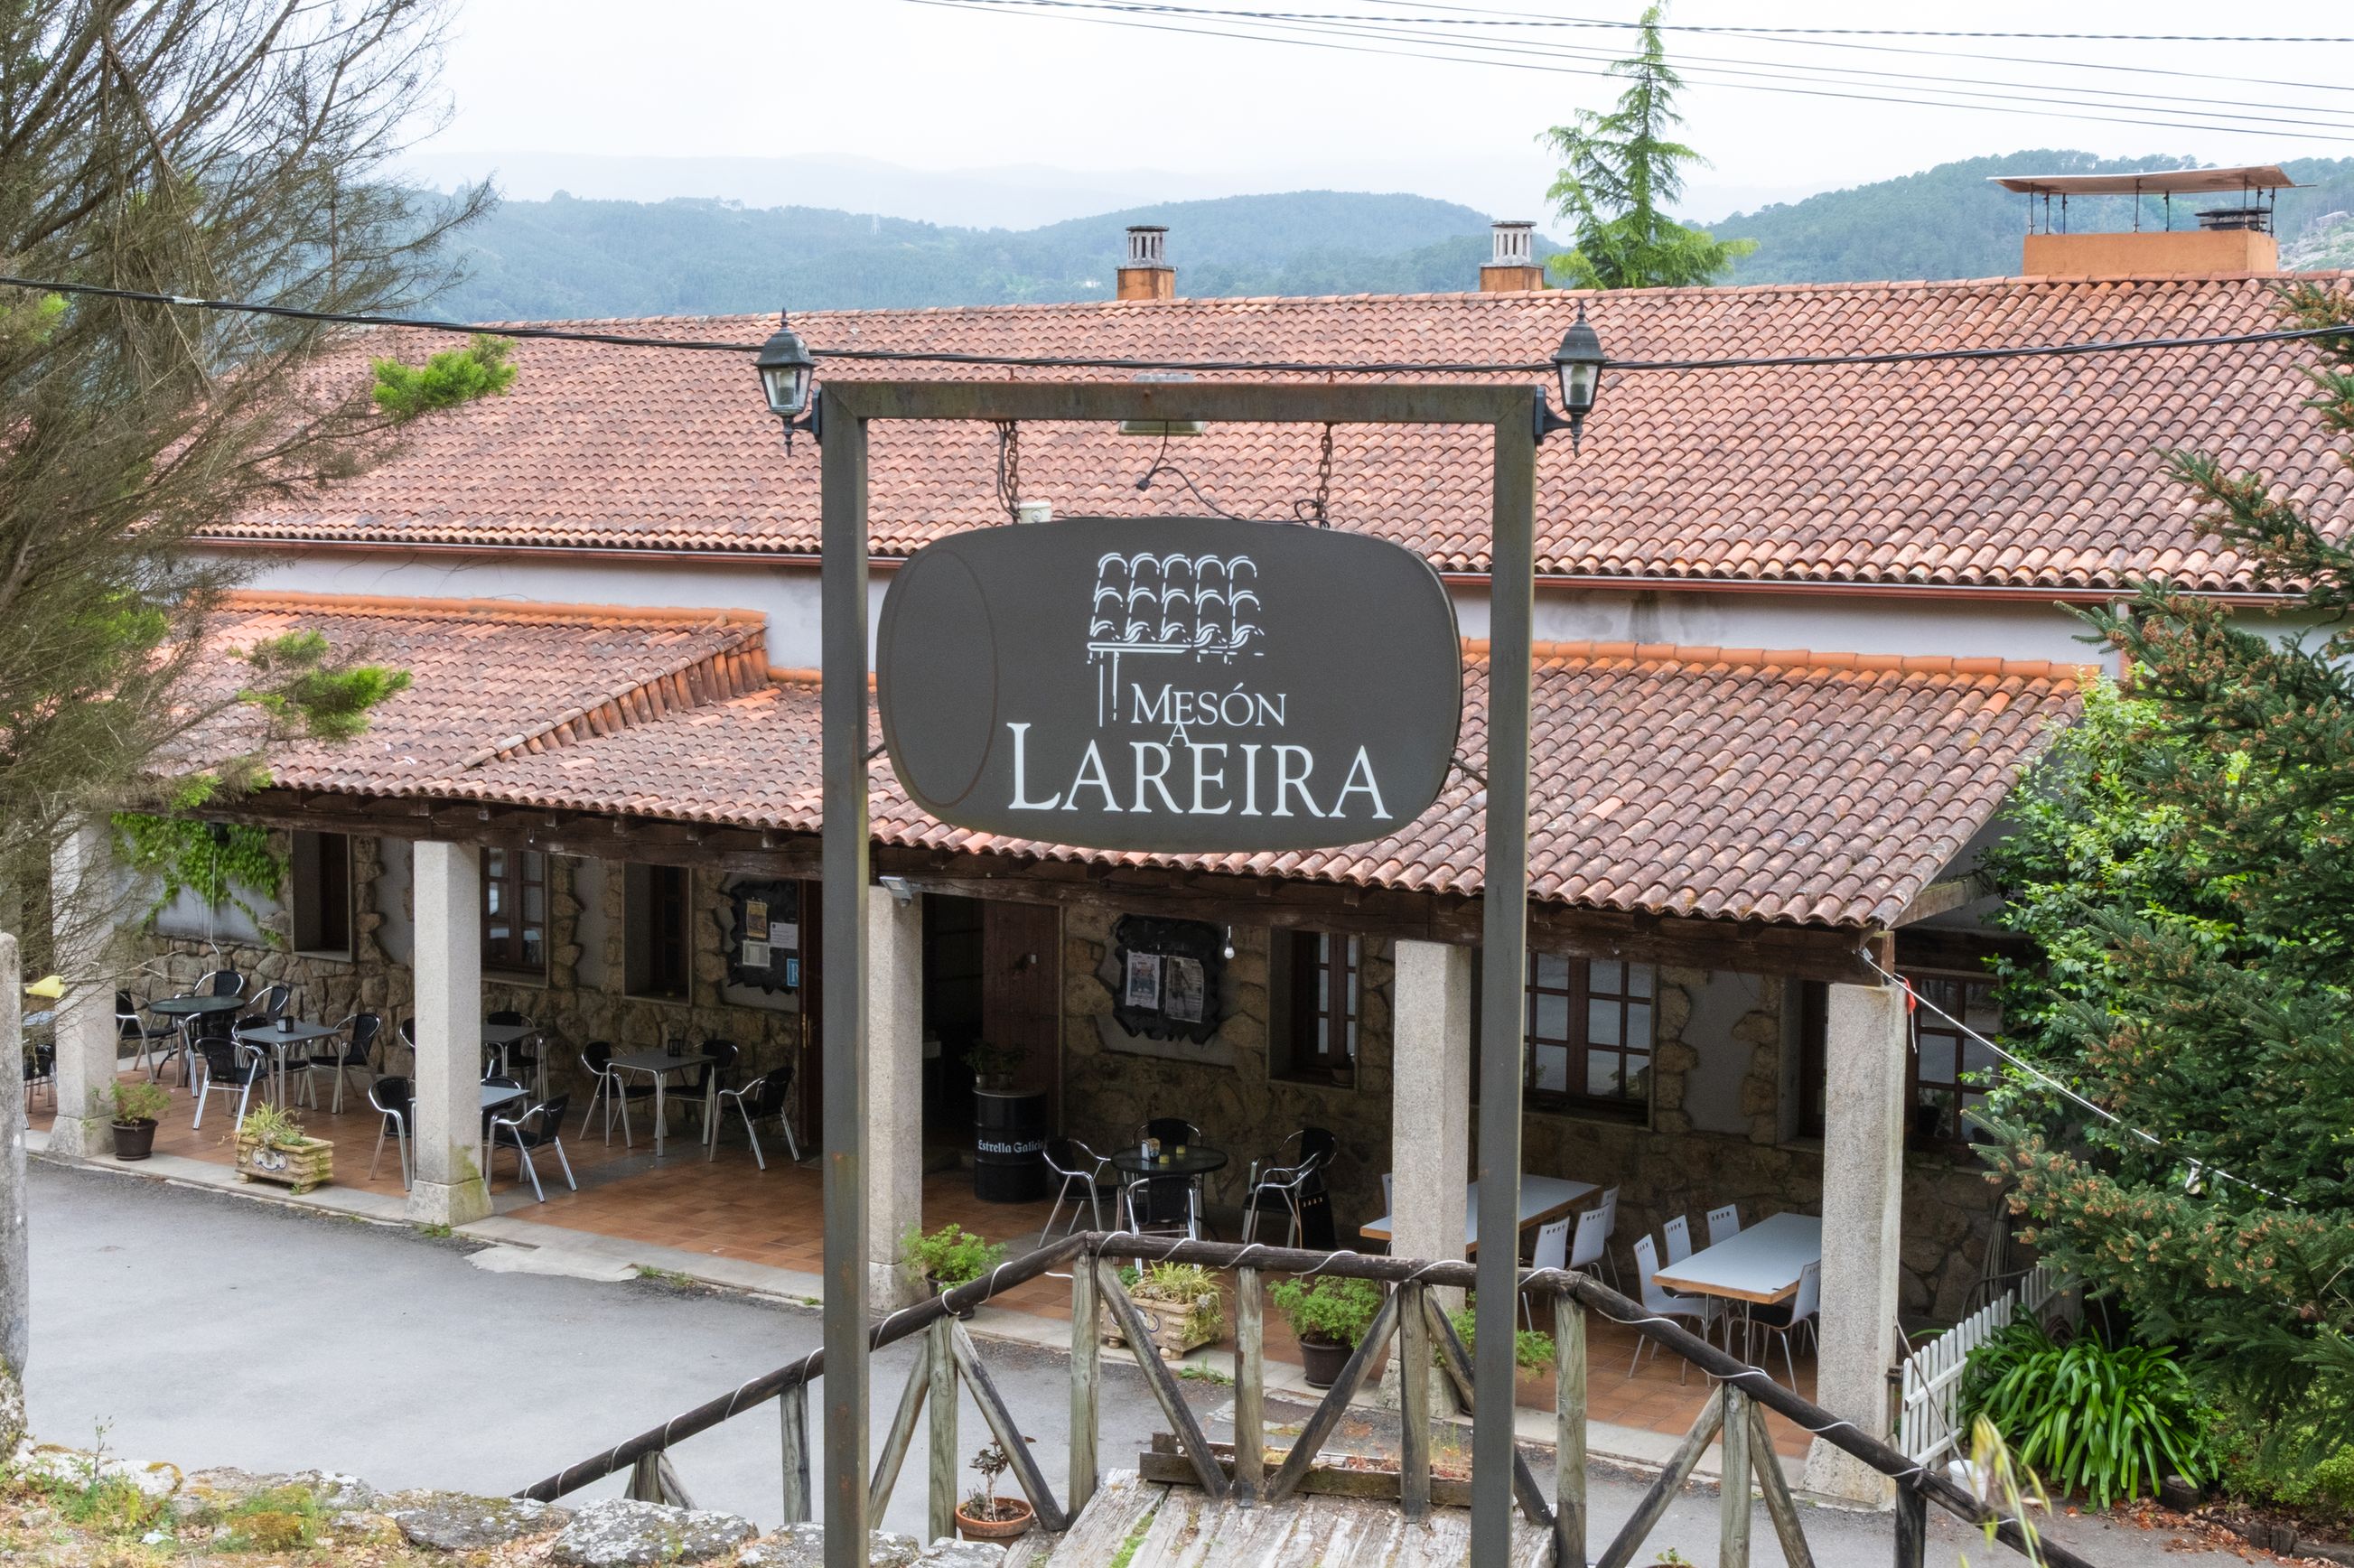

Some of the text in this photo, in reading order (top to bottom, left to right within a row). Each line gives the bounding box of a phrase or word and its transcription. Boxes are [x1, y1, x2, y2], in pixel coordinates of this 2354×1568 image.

[1131, 682, 1287, 727] MESÓN
[1165, 723, 1192, 748] A
[1006, 722, 1394, 820] LAREIRA
[978, 1139, 1012, 1153] Estrella
